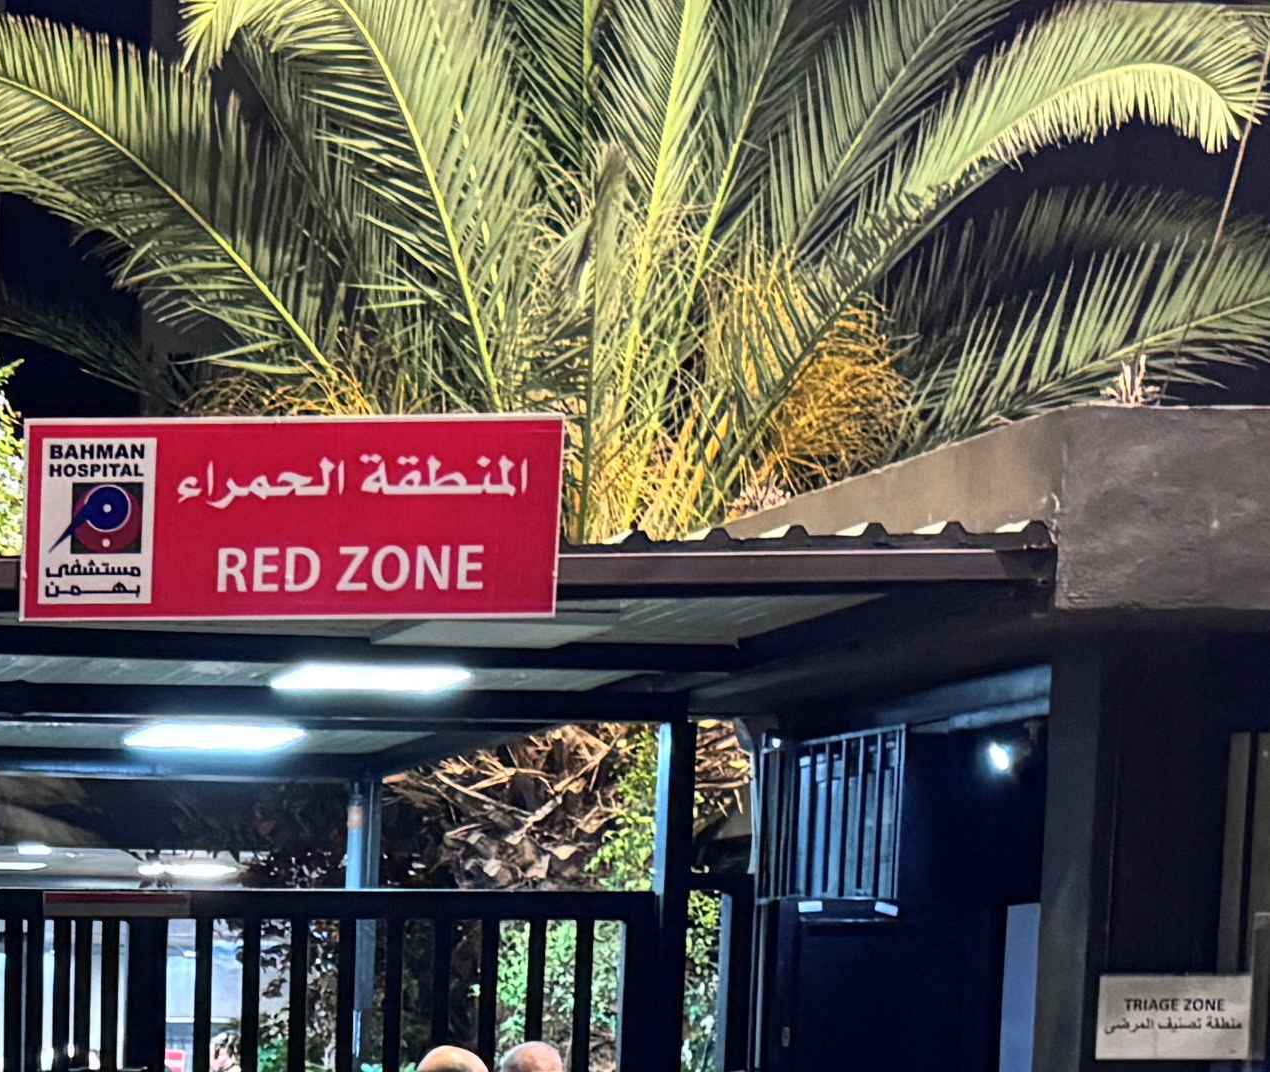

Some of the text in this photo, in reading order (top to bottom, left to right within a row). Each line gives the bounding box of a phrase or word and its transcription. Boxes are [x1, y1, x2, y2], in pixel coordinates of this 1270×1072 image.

[49, 443, 146, 460] BAHMAN
[48, 463, 145, 478] HOSPITAL
[177, 454, 528, 509] المنطقة الحمراء
[45, 558, 141, 578] مستشفى
[217, 545, 485, 593] RED ZONE
[1124, 997, 1226, 1012] TRIAGE ZONE
[1158, 1016, 1203, 1033] تصنيف
[1206, 1015, 1244, 1031] منطقة
